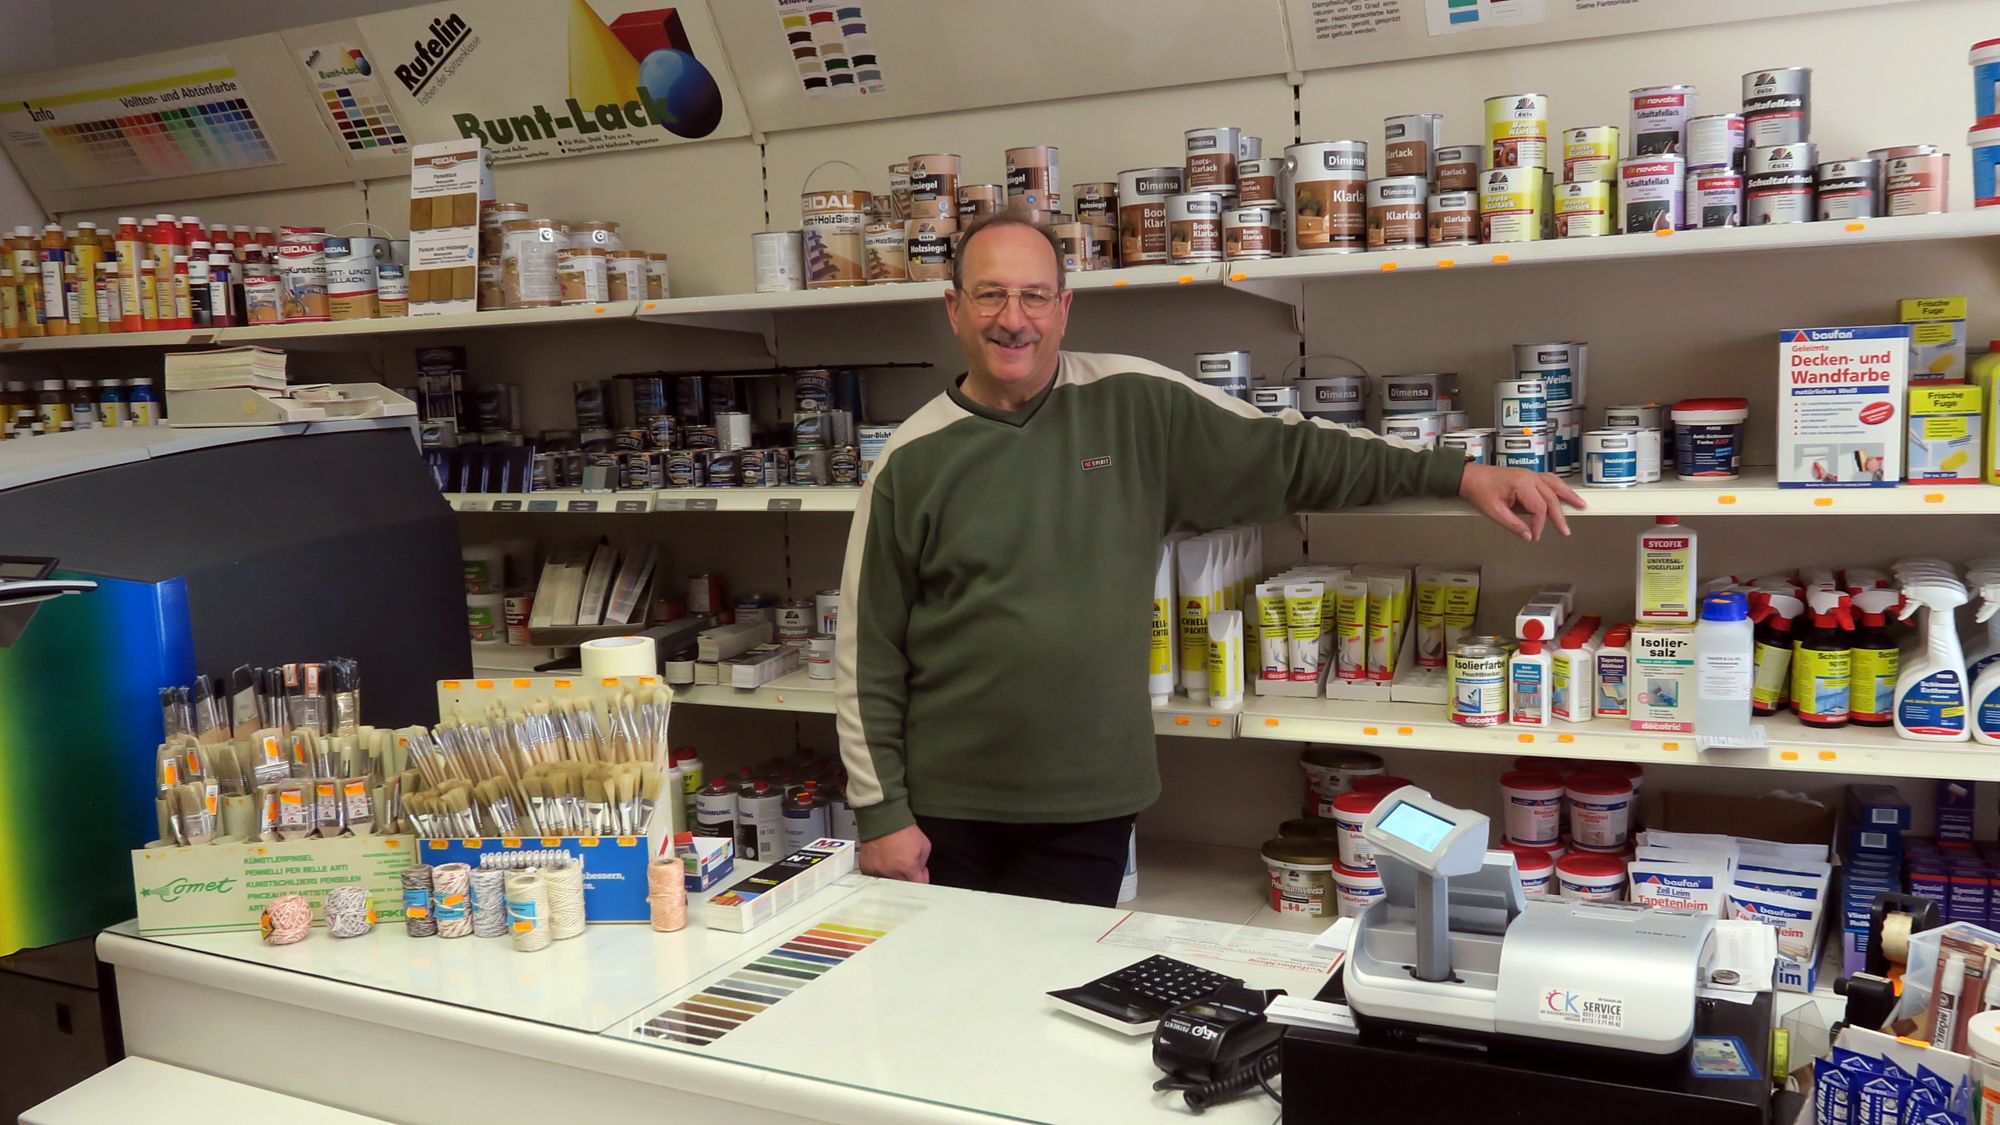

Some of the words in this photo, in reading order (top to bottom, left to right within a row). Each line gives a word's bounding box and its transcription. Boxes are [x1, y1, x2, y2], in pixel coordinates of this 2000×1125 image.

[394, 13, 467, 91] Rufelin
[162, 90, 180, 102] und
[453, 86, 680, 149] Bunt-Lack
[1636, 108, 1680, 119] Schultafellack
[1189, 138, 1214, 147] Dimensa
[1191, 158, 1212, 167] Boots-
[1328, 155, 1365, 166] Dimensa
[1191, 163, 1218, 173] Klarlack
[1440, 168, 1467, 176] Klarlack
[1139, 181, 1179, 191] Dimensa
[1626, 177, 1670, 188] Schultafellack
[1748, 175, 1813, 188] Schultafellack
[1333, 190, 1366, 203] Klarla
[1383, 188, 1413, 197] Dimensa
[1441, 198, 1465, 206] Dimensa
[1189, 203, 1217, 212] Dimensa
[1386, 211, 1423, 220] Klarlack
[1443, 215, 1472, 223] Klarlack
[1192, 222, 1215, 231] Boots-
[1192, 229, 1218, 237] Klarlack
[910, 244, 947, 254] Holzsiegel
[1916, 299, 1950, 308] Frische
[1922, 306, 1945, 315] Fuge
[1812, 330, 1854, 341] baufan
[1791, 343, 1830, 353] Geleimte
[1791, 353, 1854, 368] Decken-
[1859, 350, 1891, 365] und
[1201, 362, 1228, 371] Dimensa
[1791, 367, 1891, 385] Wandfarbe
[1319, 390, 1357, 399] Dimensa
[1391, 387, 1429, 397] Dimensa
[1927, 391, 1964, 400] Frische
[1933, 400, 1958, 409] Fuge
[1508, 456, 1540, 465] Weißlack
[1648, 540, 1683, 548] SYCOFIX
[1183, 626, 1208, 634] SPACHTE
[1641, 637, 1688, 648] Isolier-
[1649, 648, 1676, 657] salz
[1454, 659, 1505, 671] Isolierfarbe
[1601, 657, 1625, 665] Tapeten
[1920, 680, 1959, 689] Schimmel
[1465, 715, 1498, 725] decotric
[1641, 722, 1681, 731] decotric
[243, 854, 314, 864] KÜNSTLERPINSEL
[245, 867, 283, 876] PENNELLI
[285, 866, 301, 874] PER
[303, 865, 328, 873] BELLE
[330, 864, 349, 872] ARTI
[246, 878, 318, 888] KUNSTSCHILDERS
[320, 875, 362, 884] PENSELEN
[1271, 879, 1324, 894] Premiumweiss
[1663, 877, 1699, 888] baufan
[160, 877, 238, 902] Comet
[1656, 886, 1671, 895] Zell
[1672, 889, 1691, 898] Leim
[1953, 887, 1985, 895] Spezial
[1638, 894, 1709, 912] Tapetenleim
[1760, 906, 1797, 918] baufan
[1751, 914, 1764, 923] Zell
[1767, 917, 1787, 927] Leim
[1545, 989, 1580, 1014] CK
[1583, 1001, 1622, 1015] SERVICE
